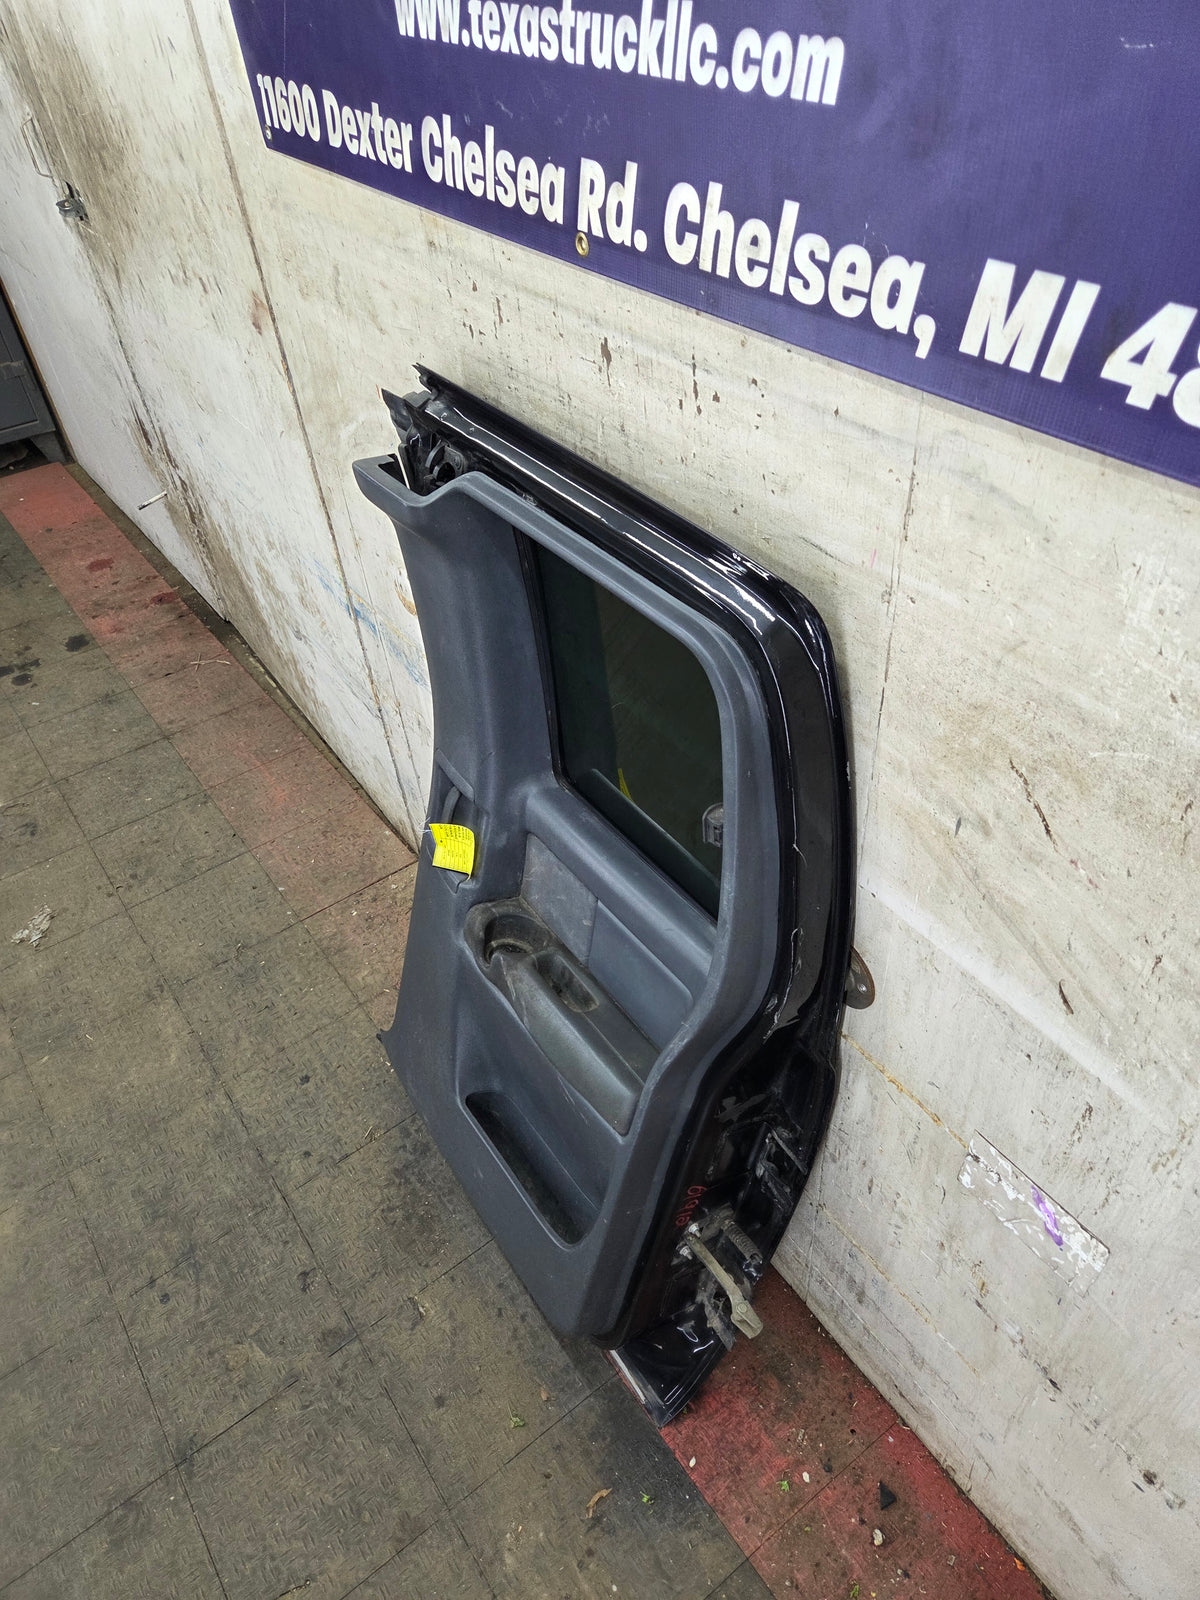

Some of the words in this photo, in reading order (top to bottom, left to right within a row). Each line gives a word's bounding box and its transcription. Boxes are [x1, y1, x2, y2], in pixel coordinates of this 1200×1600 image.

[394, 0, 846, 106] www.texastruckllc.com
[256, 73, 321, 142] 11600
[321, 88, 413, 174] Dexter
[421, 114, 566, 225] Chelsea
[577, 157, 648, 253] Rd.
[663, 181, 936, 360] Chelsea,
[958, 257, 1102, 383] MI
[1100, 301, 1200, 429] 4
